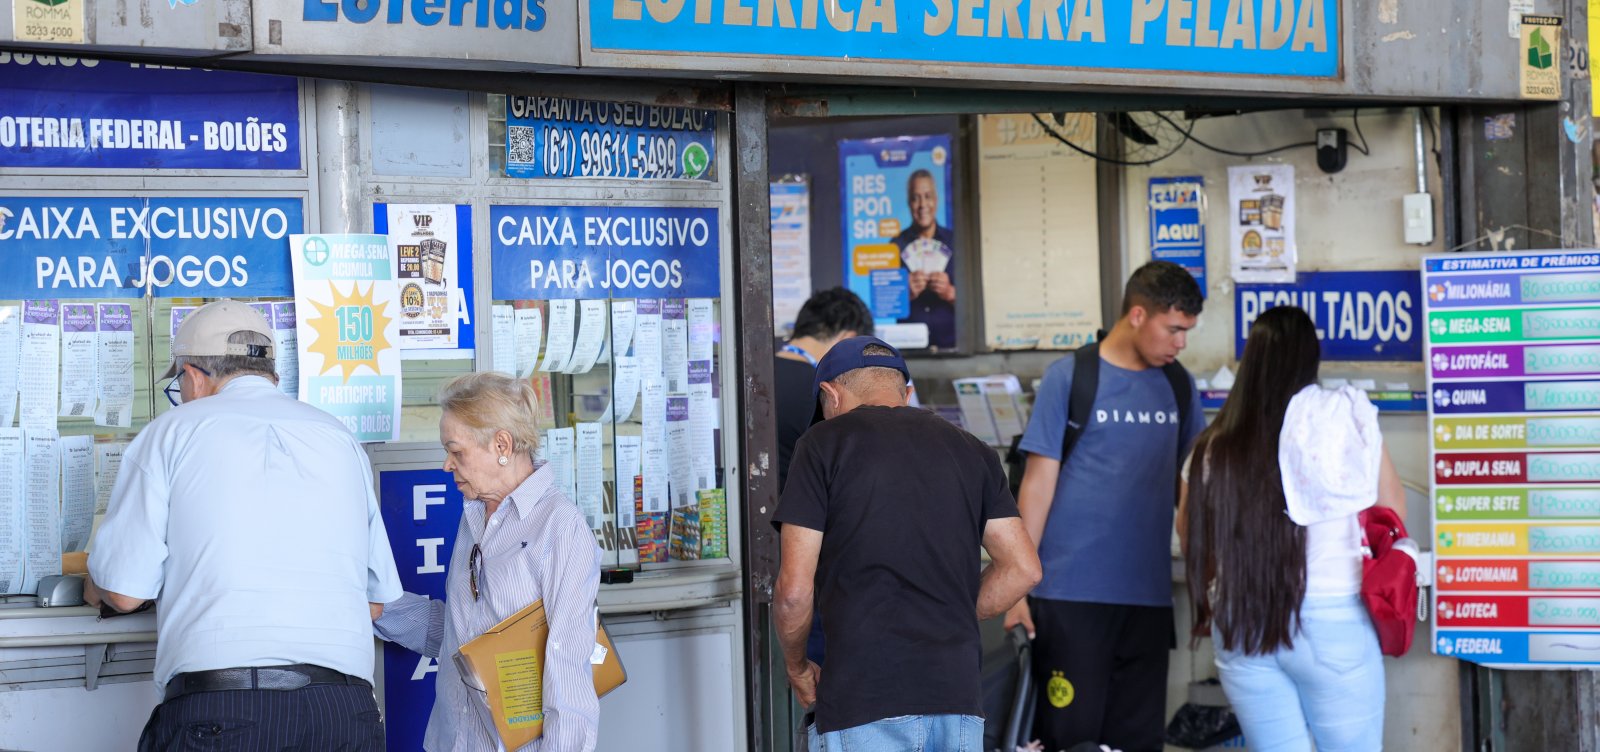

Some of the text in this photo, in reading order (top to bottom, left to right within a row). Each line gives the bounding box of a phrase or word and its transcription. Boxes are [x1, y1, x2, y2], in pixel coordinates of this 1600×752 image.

[26, 6, 71, 20] ROMMA
[26, 25, 73, 37] 3233 4000
[923, 0, 1106, 43] SERRA
[1129, 0, 1328, 53] PELADA
[0, 115, 85, 148] OTERIA
[90, 118, 185, 150] FEDERAL
[203, 116, 287, 153] BOLÕES
[543, 126, 677, 179] (61) 99611-5499
[853, 174, 886, 194] RES
[0, 206, 288, 240] CAIXA EXCLUSIVO
[413, 214, 432, 227] VIP
[497, 215, 710, 247] CAIXA EXCLUSIVO
[853, 219, 878, 239] SA
[1157, 225, 1198, 240] AQUI
[400, 246, 415, 257] LEVE
[331, 261, 373, 277] ACUMULA
[1442, 254, 1600, 270] ESTIMATIVA DE PRÊMIOS
[36, 255, 249, 289] PARA JOGOS
[530, 259, 683, 289] PARA JOGOS
[335, 305, 373, 342] 150
[1242, 291, 1412, 342] RLTADOS
[1449, 317, 1511, 334] MEGA-SENA
[337, 344, 373, 360] MILHÕES
[1451, 351, 1509, 370] LOTOFÁCIL
[320, 385, 387, 404] PARTICIPE DE
[1452, 389, 1487, 405] QUINA
[361, 411, 391, 433] BOLÕES
[1096, 409, 1178, 424] DIAMON
[1455, 425, 1473, 440] DIA
[1475, 425, 1489, 439] DE
[1491, 425, 1525, 439] SORTE
[1454, 461, 1489, 476] DUPLA
[1492, 460, 1521, 475] SENA
[1455, 497, 1491, 512] SUPER
[1492, 496, 1520, 511] SETE
[1455, 567, 1518, 582] LOTOMANIA
[1455, 603, 1498, 619] LOTECA
[1455, 639, 1503, 655] FEDERAL
